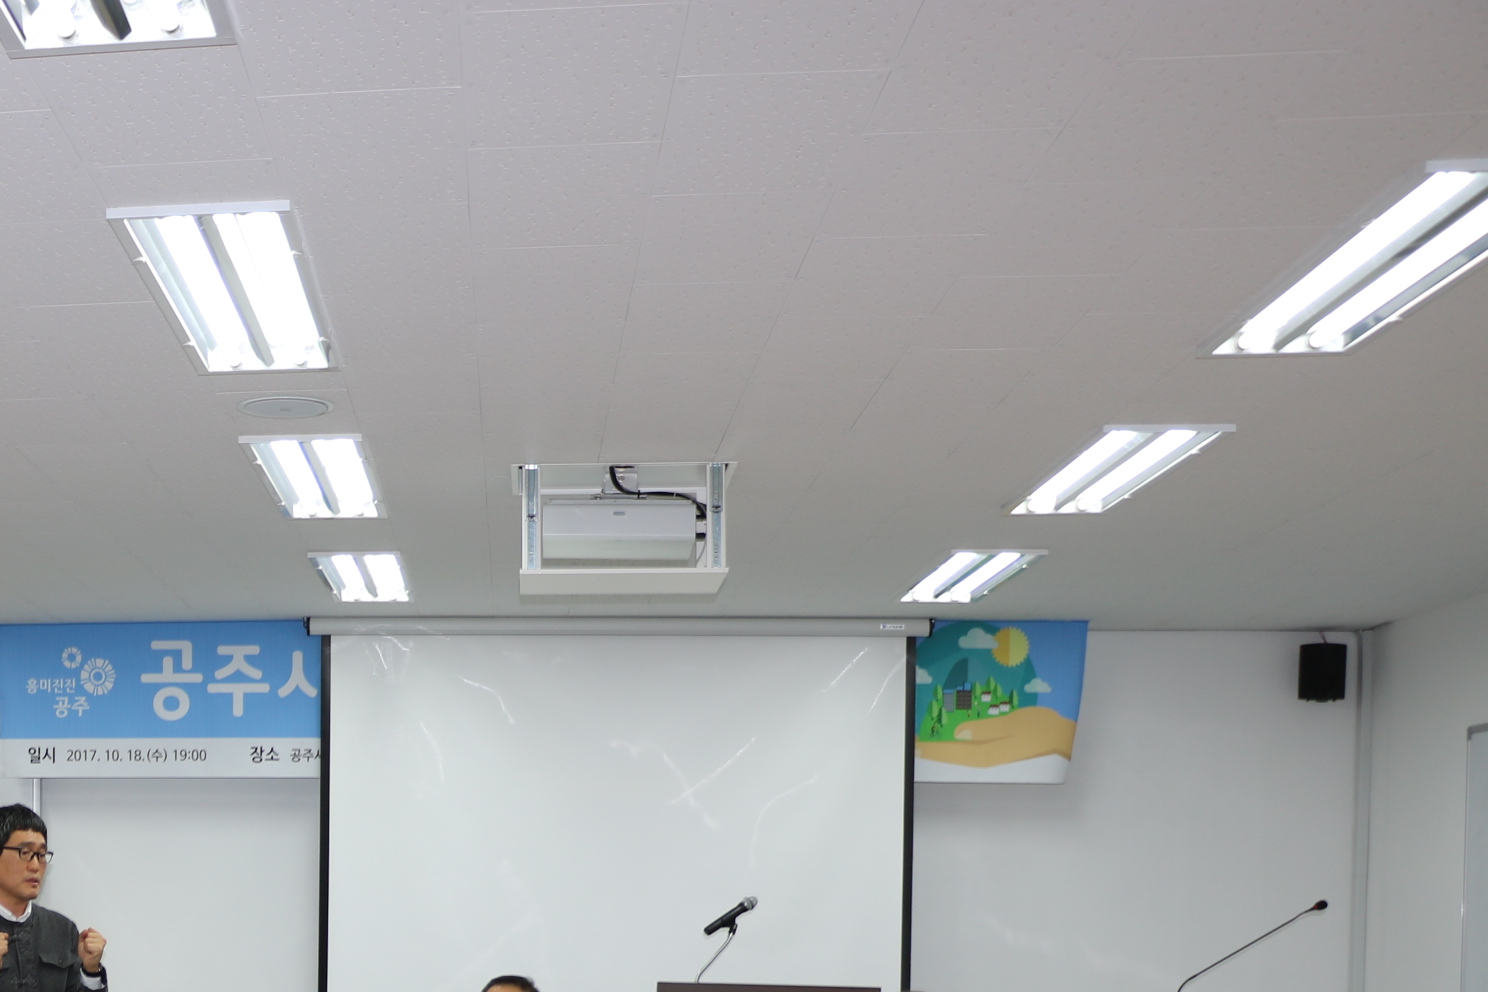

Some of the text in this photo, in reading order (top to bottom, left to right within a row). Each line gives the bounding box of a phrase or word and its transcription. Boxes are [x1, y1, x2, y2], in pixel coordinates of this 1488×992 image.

[25, 677, 76, 695] 흥미진진
[52, 696, 90, 718] 공주
[27, 746, 57, 764] 일시
[66, 748, 101, 762] 2017.
[105, 748, 123, 762] 10.
[172, 748, 207, 762] 19:00
[250, 745, 280, 764] 장소
